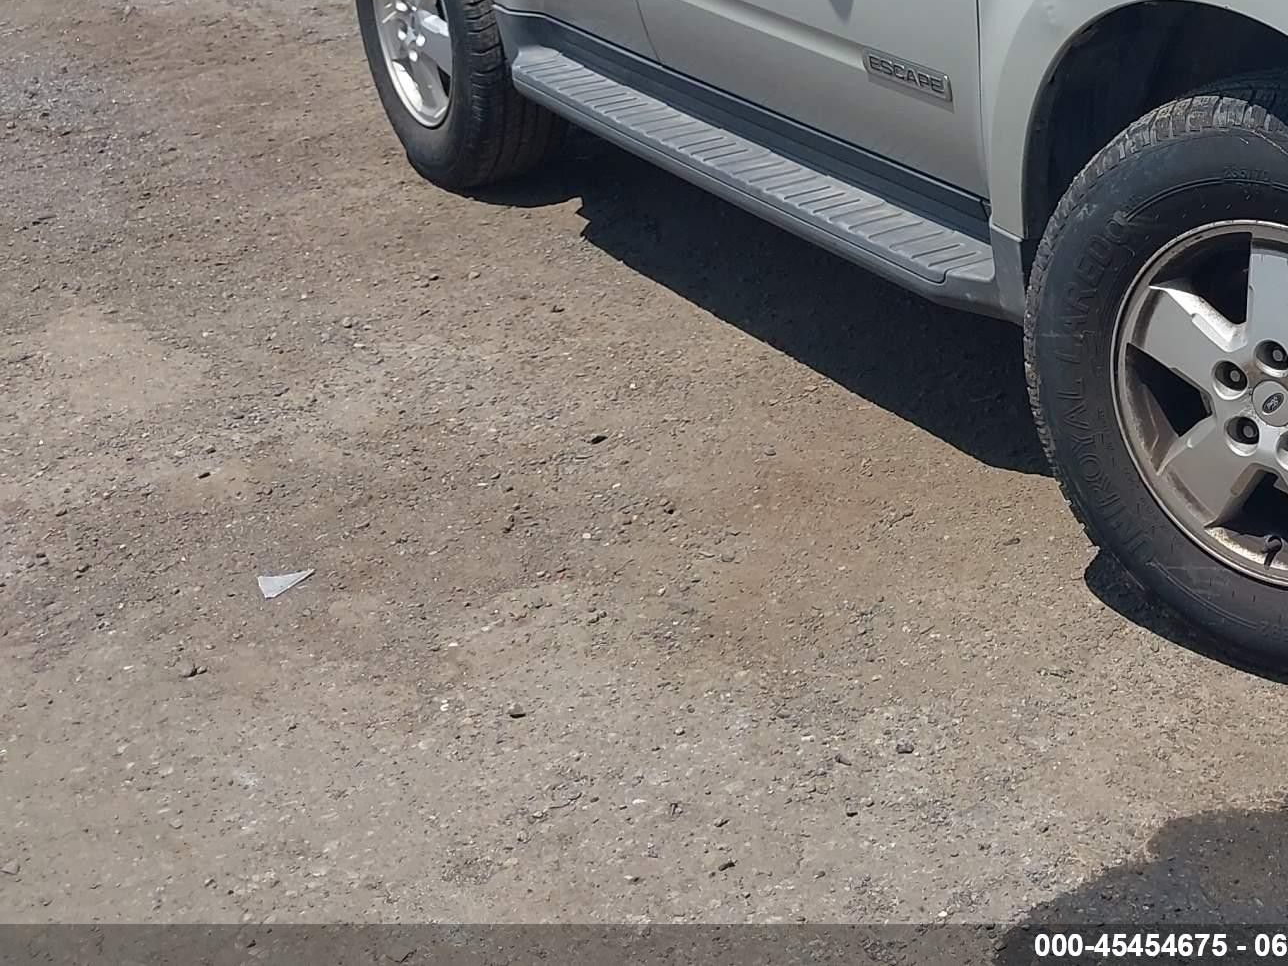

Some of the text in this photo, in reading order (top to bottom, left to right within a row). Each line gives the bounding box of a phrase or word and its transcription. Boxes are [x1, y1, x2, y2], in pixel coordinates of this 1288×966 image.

[868, 54, 944, 95] ESCAPE
[1055, 219, 1153, 564] UNIROYAL LAREDO
